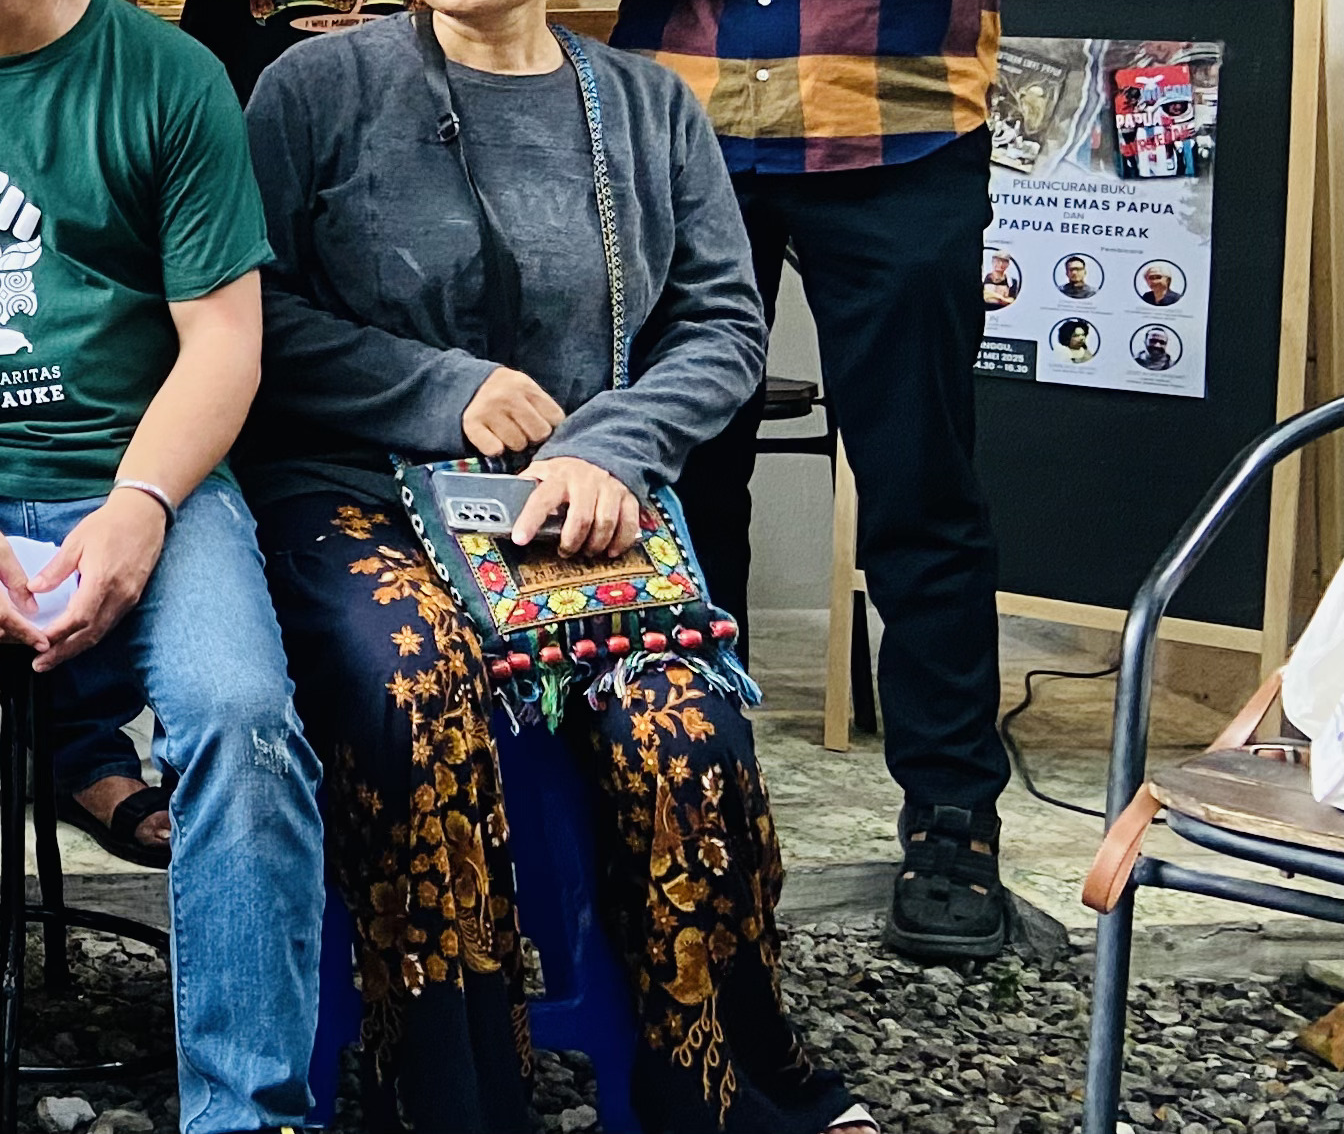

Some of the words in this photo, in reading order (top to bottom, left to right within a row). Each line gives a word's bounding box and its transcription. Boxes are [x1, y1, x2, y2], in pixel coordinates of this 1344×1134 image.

[1012, 178, 1097, 194] PELUNCURAN
[1100, 184, 1137, 195] BUKU
[990, 193, 1058, 208] UTUKAN
[1063, 197, 1111, 211] EMAS
[1116, 201, 1175, 215] PAPUA
[1063, 211, 1085, 220] DAN
[998, 218, 1055, 233] PAPUA
[1060, 223, 1149, 239] BERGERAK
